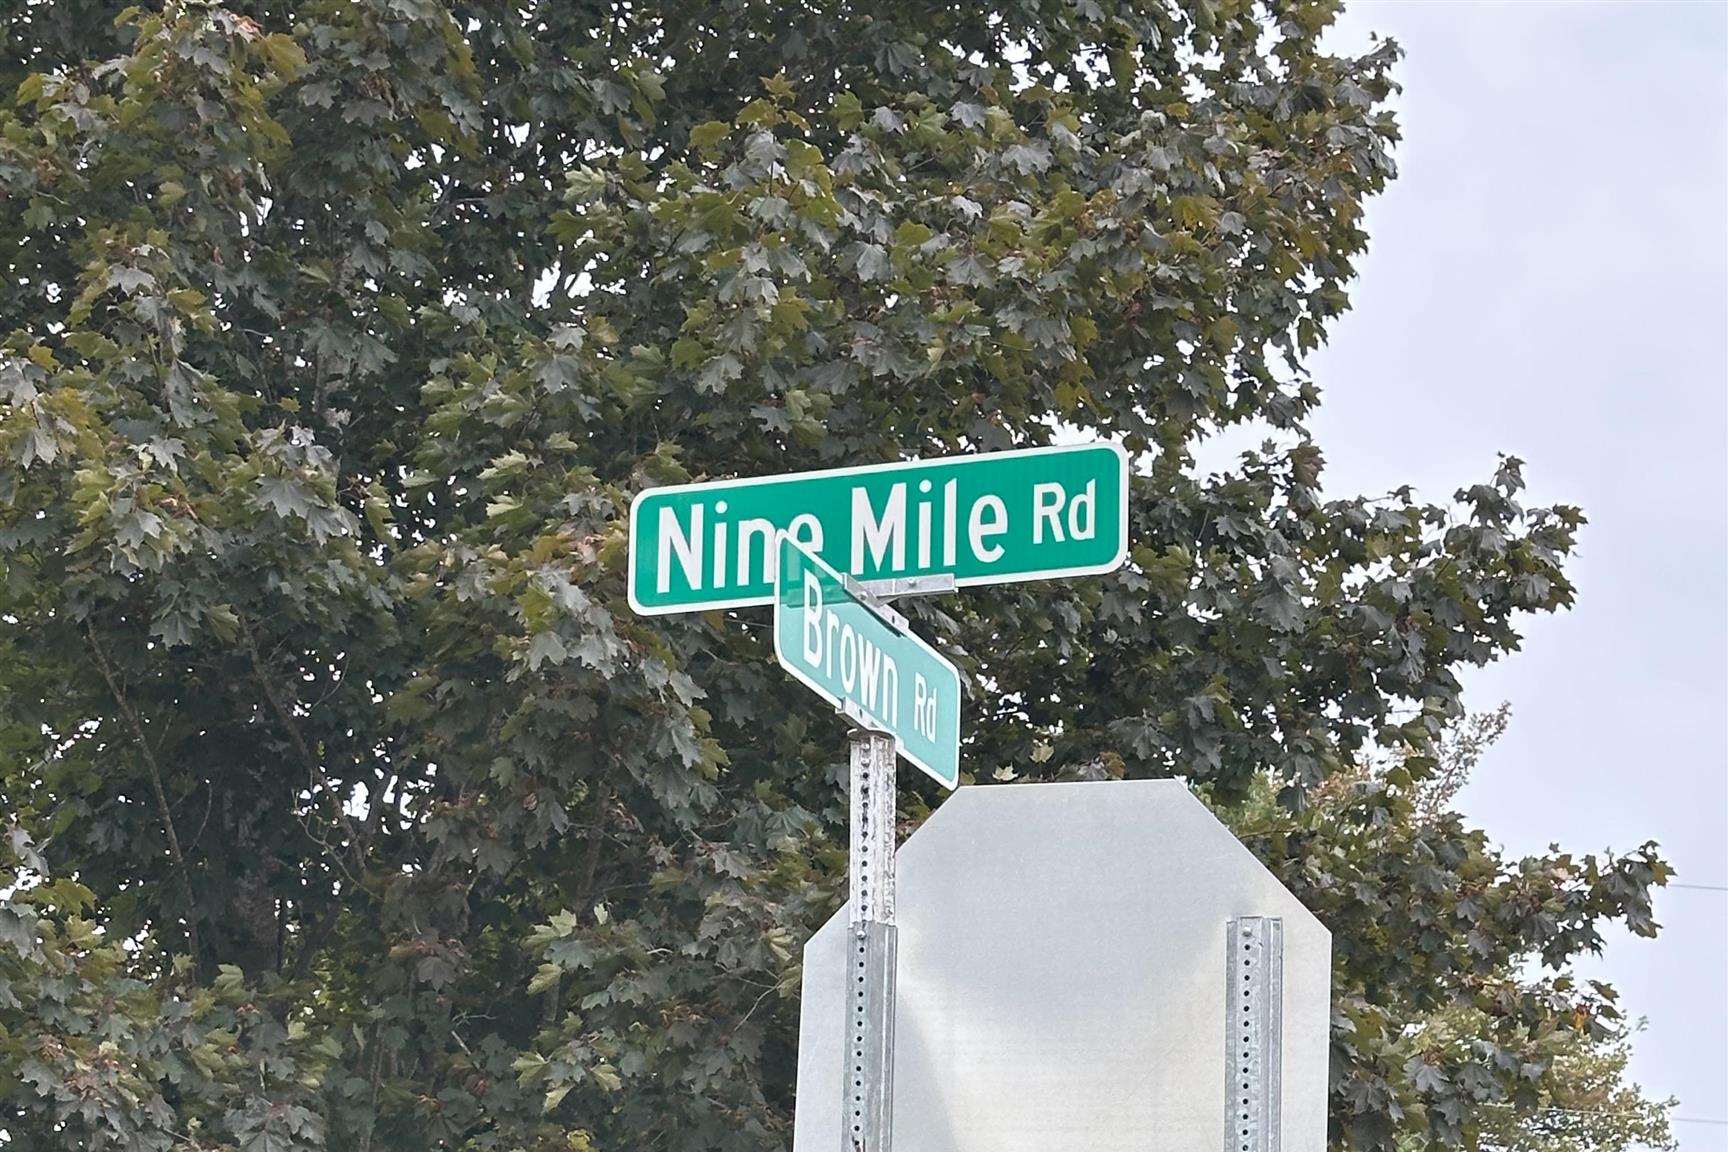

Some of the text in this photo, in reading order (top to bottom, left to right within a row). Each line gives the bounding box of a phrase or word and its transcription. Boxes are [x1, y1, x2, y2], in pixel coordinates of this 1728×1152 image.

[851, 479, 1008, 575] Mile
[1033, 479, 1096, 544] Rd
[803, 569, 938, 744] Brown Rd
